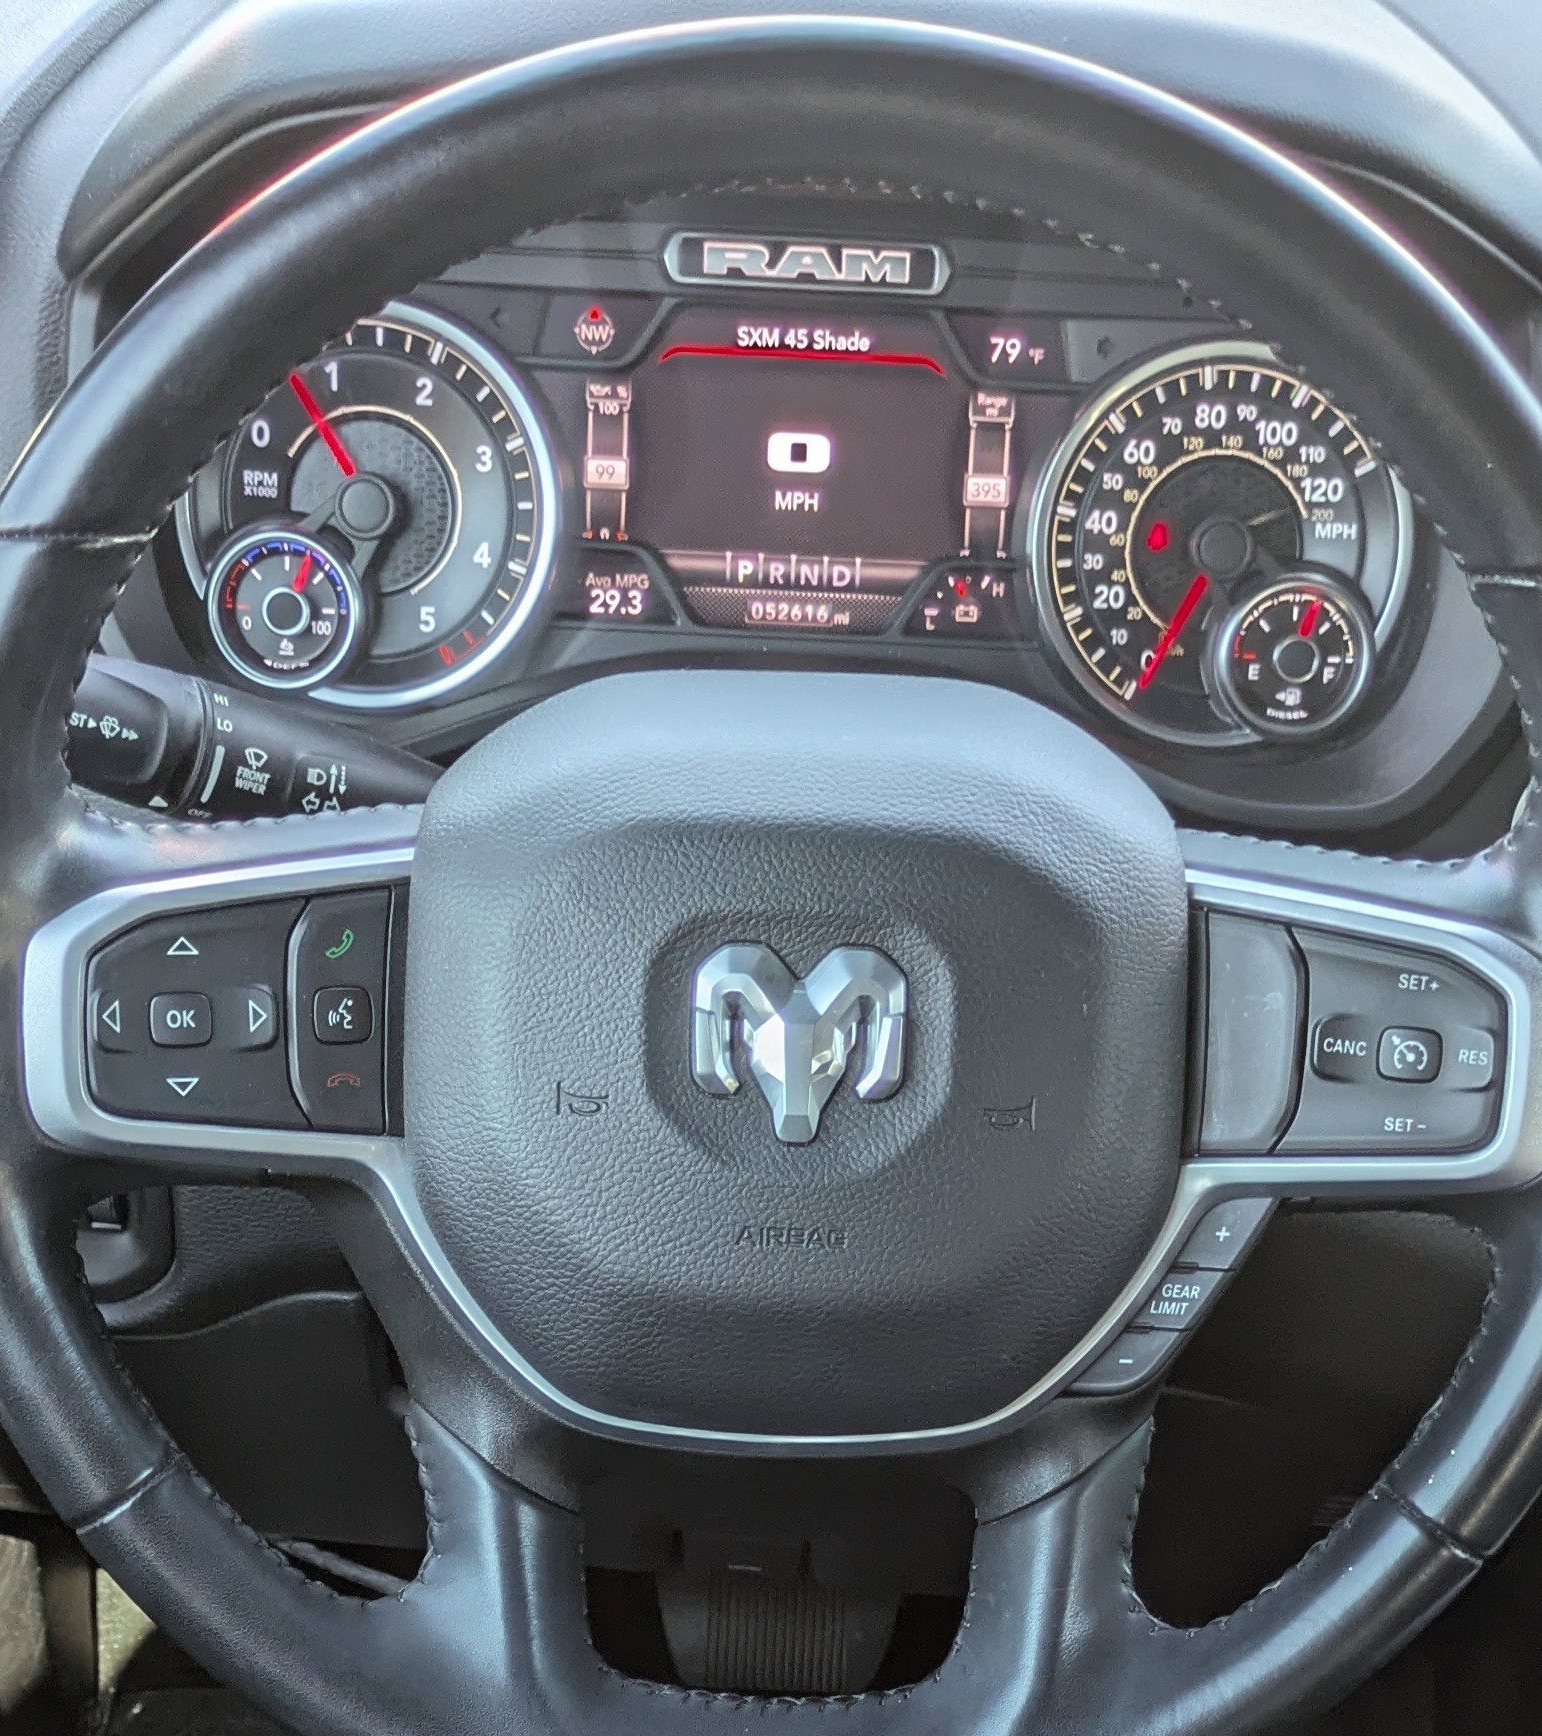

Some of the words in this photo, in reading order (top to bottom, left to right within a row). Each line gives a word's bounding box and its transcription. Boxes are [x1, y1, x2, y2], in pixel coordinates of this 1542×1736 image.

[703, 240, 910, 284] RAM
[580, 325, 610, 342] NW
[737, 326, 780, 348] SXM
[784, 329, 809, 349] 45
[812, 331, 870, 352] Shade
[989, 337, 1021, 364] 79
[324, 360, 339, 392] 1
[416, 376, 433, 406] 2
[1195, 404, 1227, 430] 80
[1236, 404, 1257, 422] 90
[251, 420, 271, 448] 0
[1162, 417, 1183, 435] 70
[1255, 420, 1299, 446] 100
[1183, 436, 1204, 451] 120
[1222, 434, 1243, 448] 140
[475, 445, 493, 473] 3
[767, 432, 831, 473] 0
[1123, 440, 1156, 465] 60
[1262, 446, 1283, 460] 160
[1299, 446, 1326, 464] 110
[243, 470, 278, 486] RPM
[596, 464, 616, 480] 99
[1137, 466, 1158, 479] 100
[1287, 463, 1307, 478] 180
[971, 482, 1001, 499] 395
[1102, 473, 1123, 490] 50
[1300, 477, 1343, 503] 120
[774, 492, 819, 513] MPH
[1123, 489, 1139, 503] 80
[1085, 510, 1117, 534] 40
[1311, 509, 1333, 522] 200
[1110, 533, 1125, 547] 60
[1315, 523, 1358, 540] MPH
[472, 542, 493, 569] 4
[1083, 553, 1104, 570] 30
[616, 573, 649, 589] MPG
[737, 560, 754, 583] P
[768, 563, 785, 585] R
[800, 564, 820, 586] N
[833, 565, 851, 587] D
[1111, 569, 1126, 582] 40
[992, 583, 1005, 597] H
[1093, 584, 1125, 610] 20
[589, 589, 643, 615] 29.3
[419, 606, 436, 632] 5
[751, 602, 829, 623] 052616
[834, 610, 850, 625] mi
[1126, 607, 1142, 620] 20
[242, 616, 252, 630] 0
[311, 620, 332, 636] 100
[925, 616, 935, 630] L
[1110, 629, 1128, 645] 10
[1247, 662, 1261, 681] E
[1322, 666, 1336, 684] F
[214, 693, 229, 707] HI
[216, 717, 233, 733] LO
[237, 765, 271, 785] FRONT
[234, 777, 267, 796] WIPER
[166, 1009, 196, 1030] OK
[1322, 1037, 1367, 1058] CANC
[1459, 1048, 1488, 1066] RES
[735, 1225, 848, 1250] AIRBAG
[1162, 1284, 1200, 1300] GEAR
[1150, 1300, 1189, 1316] LIMIT
